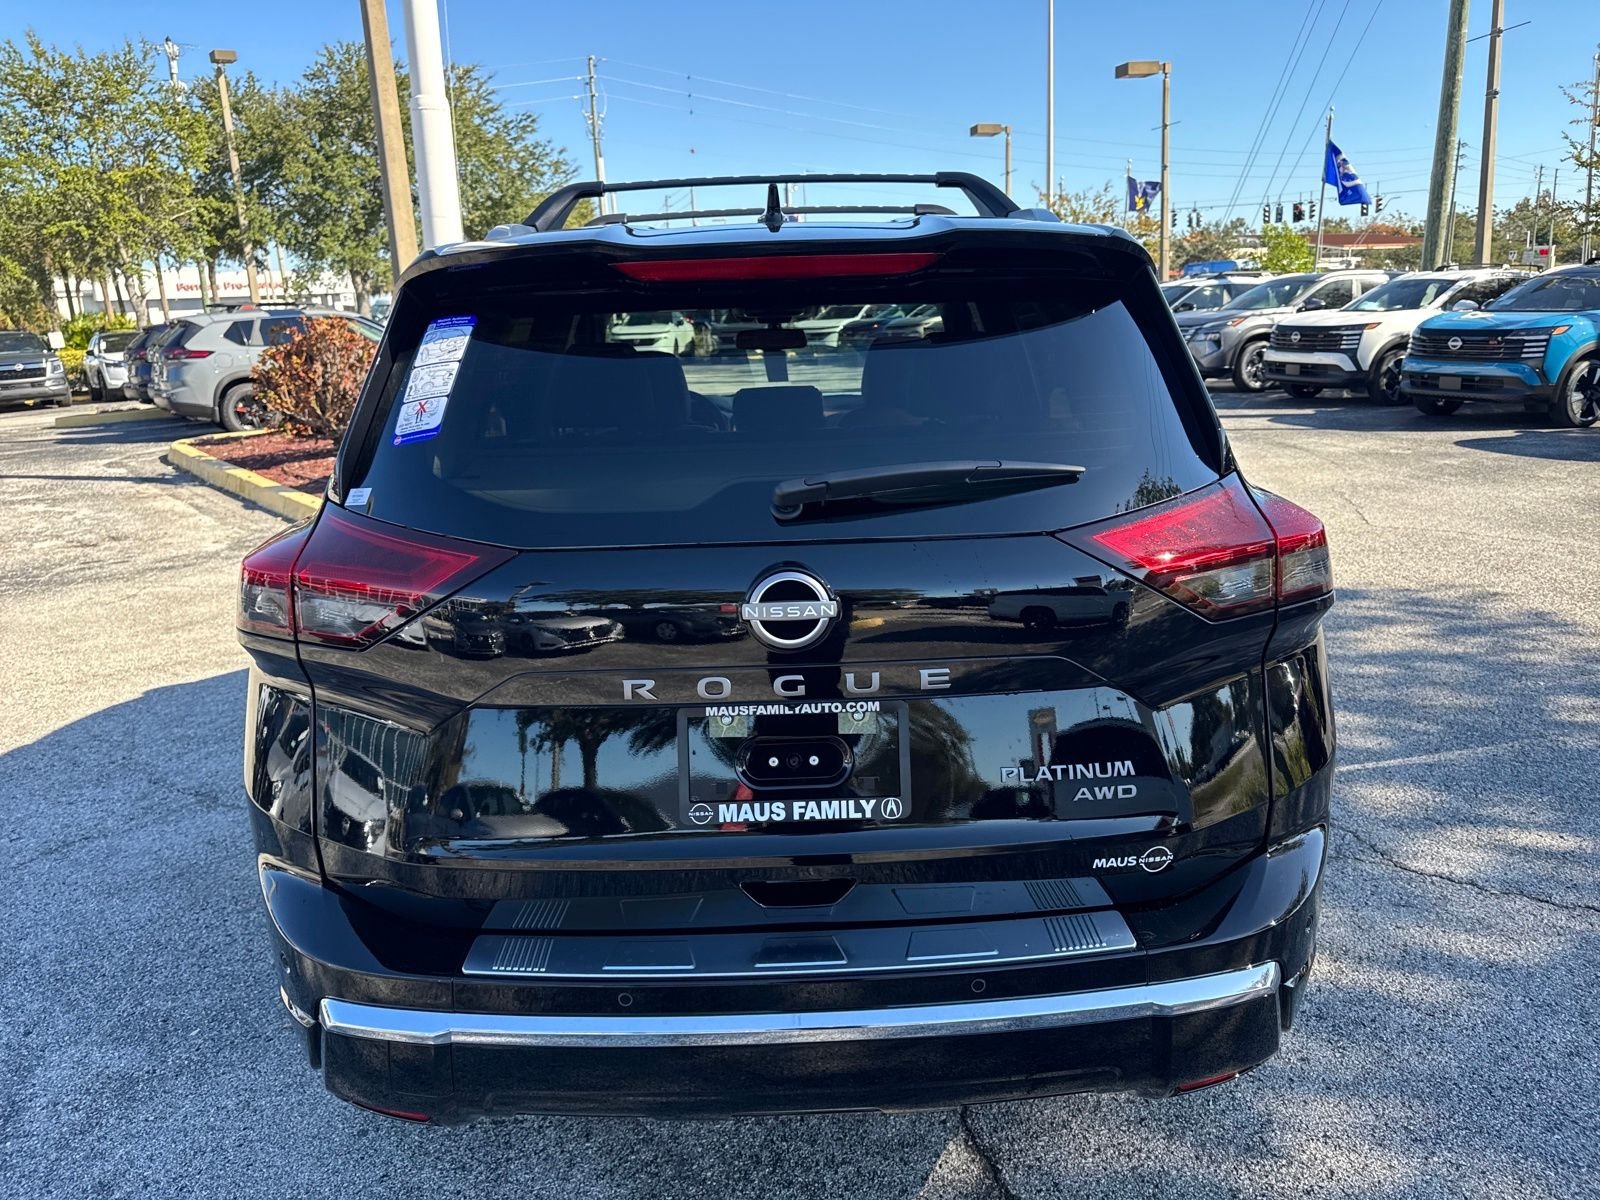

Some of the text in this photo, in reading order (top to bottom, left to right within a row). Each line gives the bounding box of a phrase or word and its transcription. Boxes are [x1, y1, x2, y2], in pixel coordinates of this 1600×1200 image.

[744, 603, 836, 619] NISSAN
[622, 668, 952, 700] ROGUE
[705, 701, 880, 717] MAUSFAMILYAUTO.COM
[1000, 760, 1136, 783] PLATINUM
[1073, 784, 1137, 801] AWD
[718, 802, 786, 823] MAUS
[793, 799, 877, 821] FAMILY
[1092, 854, 1174, 869] MAUS NISSAN
